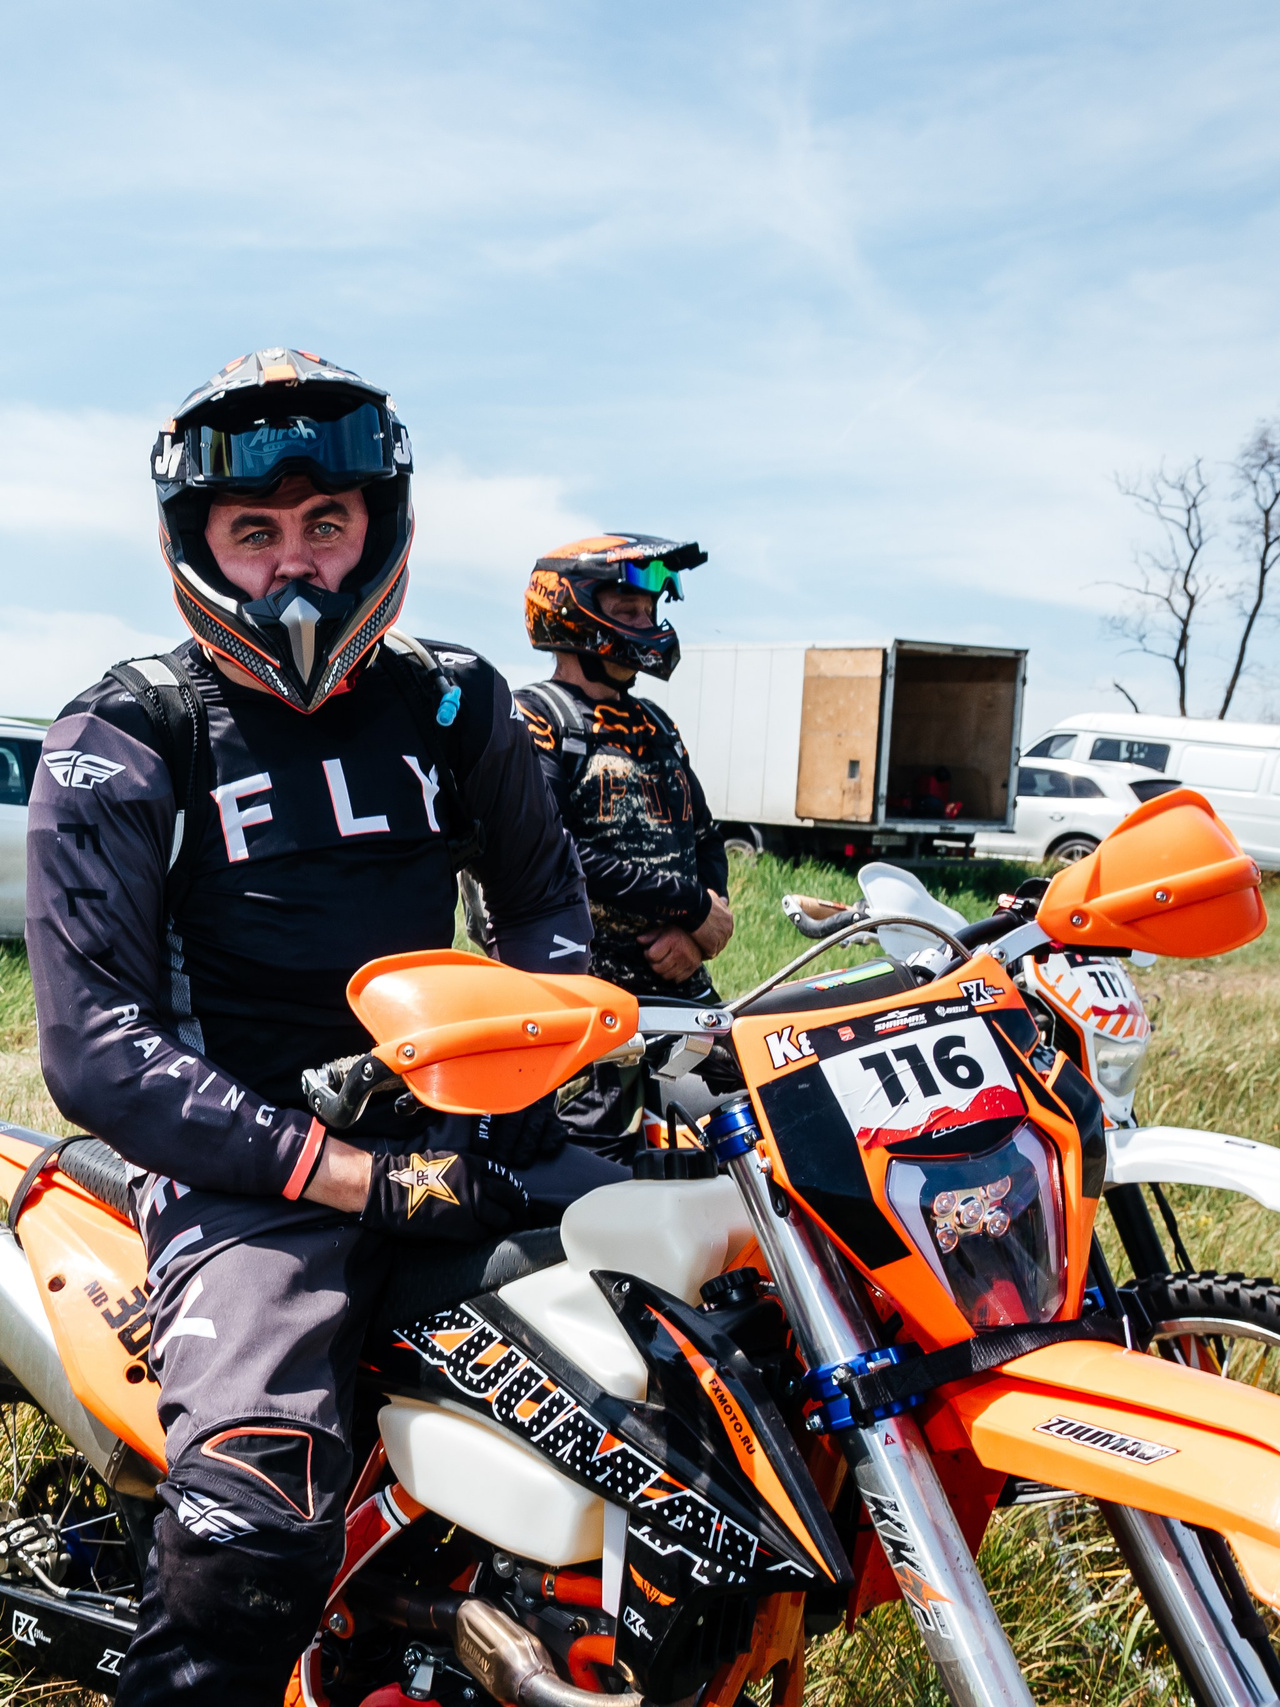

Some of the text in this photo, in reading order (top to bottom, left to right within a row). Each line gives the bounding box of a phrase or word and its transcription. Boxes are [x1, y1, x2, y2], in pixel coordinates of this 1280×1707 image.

[248, 419, 318, 447] Airoh
[209, 755, 441, 863] FLY
[112, 1003, 276, 1127] RACING
[859, 1035, 985, 1108] 116
[709, 1378, 756, 1455] FXMOTO.RU
